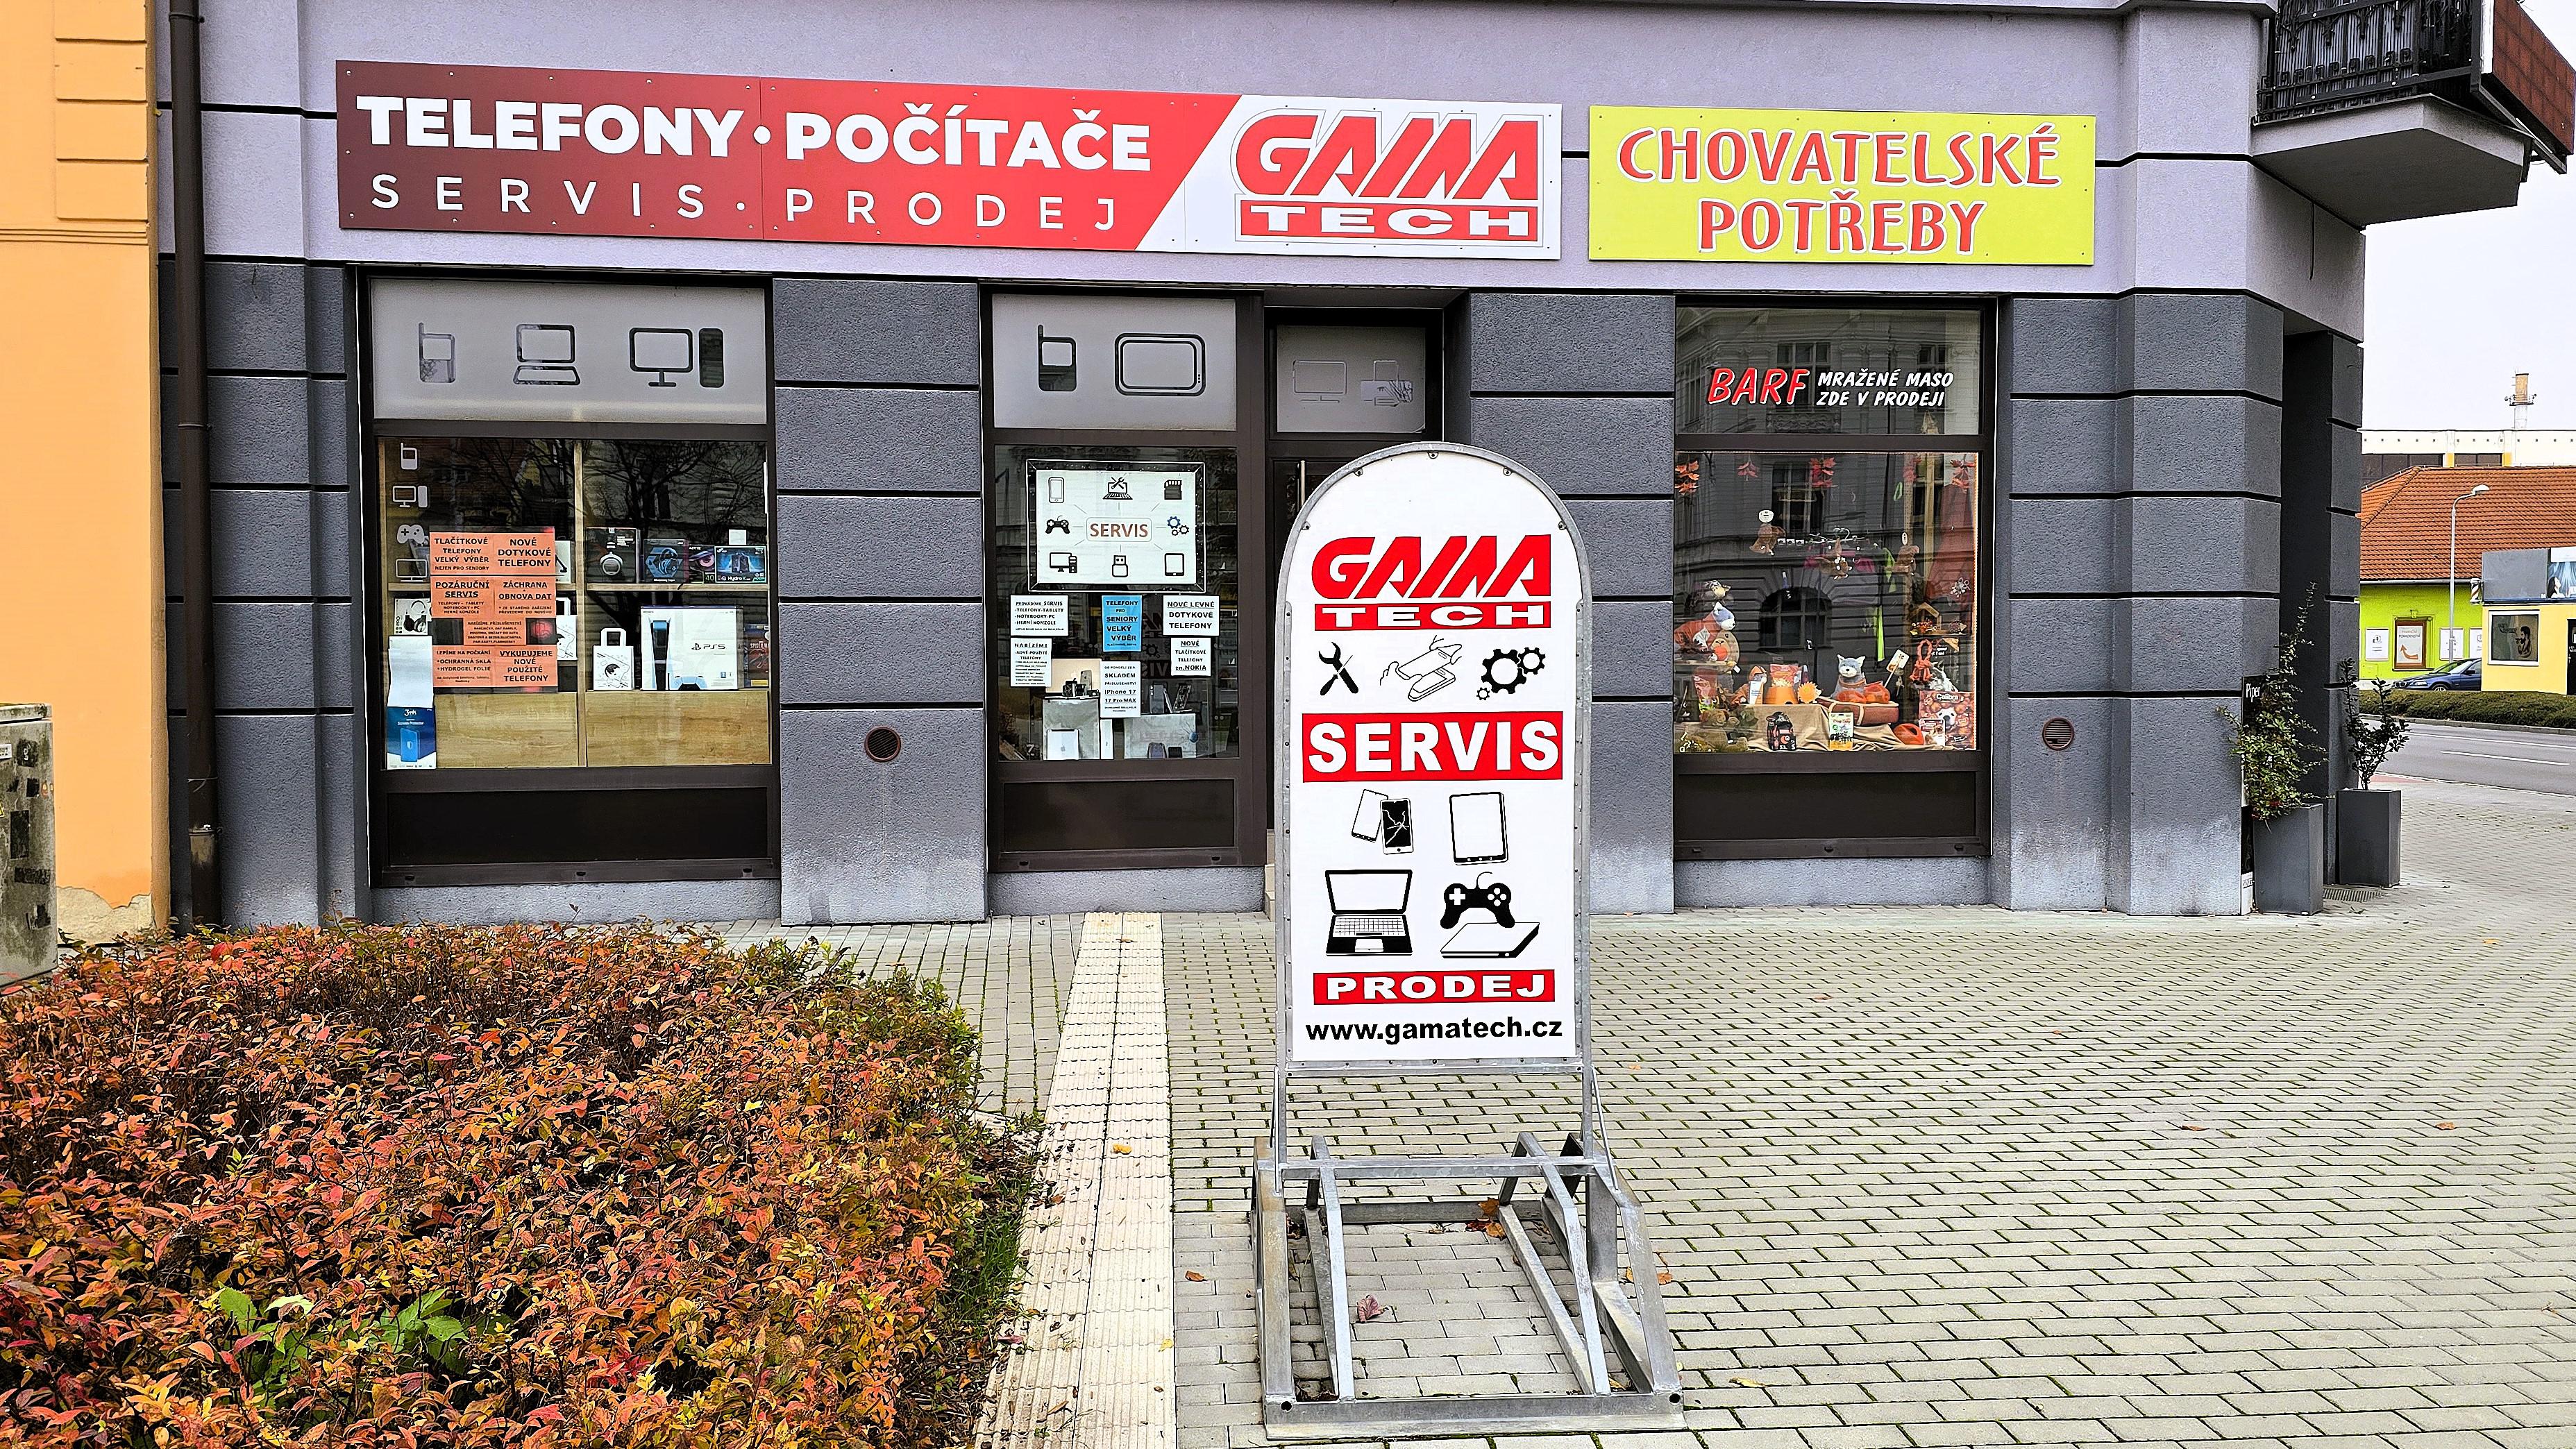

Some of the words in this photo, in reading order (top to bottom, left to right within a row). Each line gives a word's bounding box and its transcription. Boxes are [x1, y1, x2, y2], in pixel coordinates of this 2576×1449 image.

[356, 95, 744, 158] TELEFONY
[786, 102, 1151, 171] POČÍTAČE
[1236, 115, 1538, 201] GAMA
[1619, 124, 2060, 186] CHOVATELSKÉ
[786, 187, 1115, 231] PRODEJ
[1250, 205, 1529, 237] TECH
[1701, 190, 1985, 253] POTŘEBY
[1708, 367, 1810, 405] BARF
[1817, 368, 1901, 387] MRAŽENÉ
[1905, 372, 1954, 387] MASO
[1816, 392, 1850, 407] ZDE
[1857, 391, 1869, 407] V
[1874, 391, 1945, 407] PRODEJI
[435, 536, 489, 545] TLAČÍTKOVÉ
[1090, 523, 1148, 538] SERVIS
[498, 547, 551, 556] DOTYKOVÉ
[510, 537, 537, 546] NOVÉ
[1311, 534, 1551, 600] GAMA
[435, 580, 489, 588] POZÁRUČNÍ
[503, 580, 547, 588] ZÁCHRANA
[1168, 610, 1213, 618] DOTYKOVÉ
[1322, 604, 1544, 627] TECH
[507, 665, 543, 673] POUŽITÉ
[514, 656, 537, 665] NOVÉ
[2246, 683, 2261, 703] Piper
[1308, 720, 1559, 774] SERVIS
[1327, 974, 1545, 1001] PRODEJ
[1305, 1016, 1563, 1045] www.gamatech.cz
